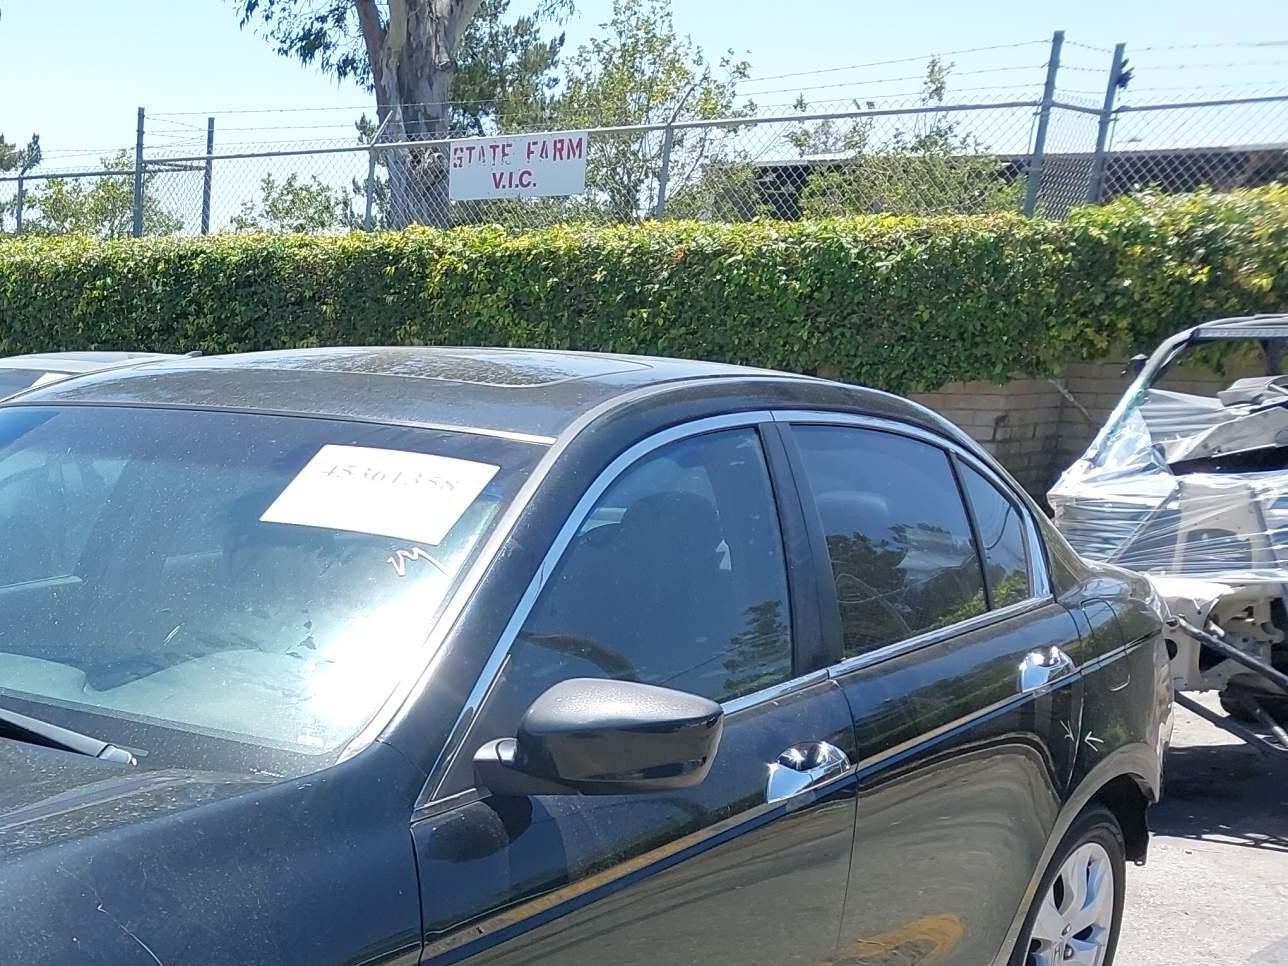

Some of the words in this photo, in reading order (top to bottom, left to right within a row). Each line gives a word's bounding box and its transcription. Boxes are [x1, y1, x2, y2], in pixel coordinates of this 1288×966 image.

[453, 142, 512, 168] STATE
[527, 137, 583, 163] FARM
[492, 170, 537, 189] V.I.C.
